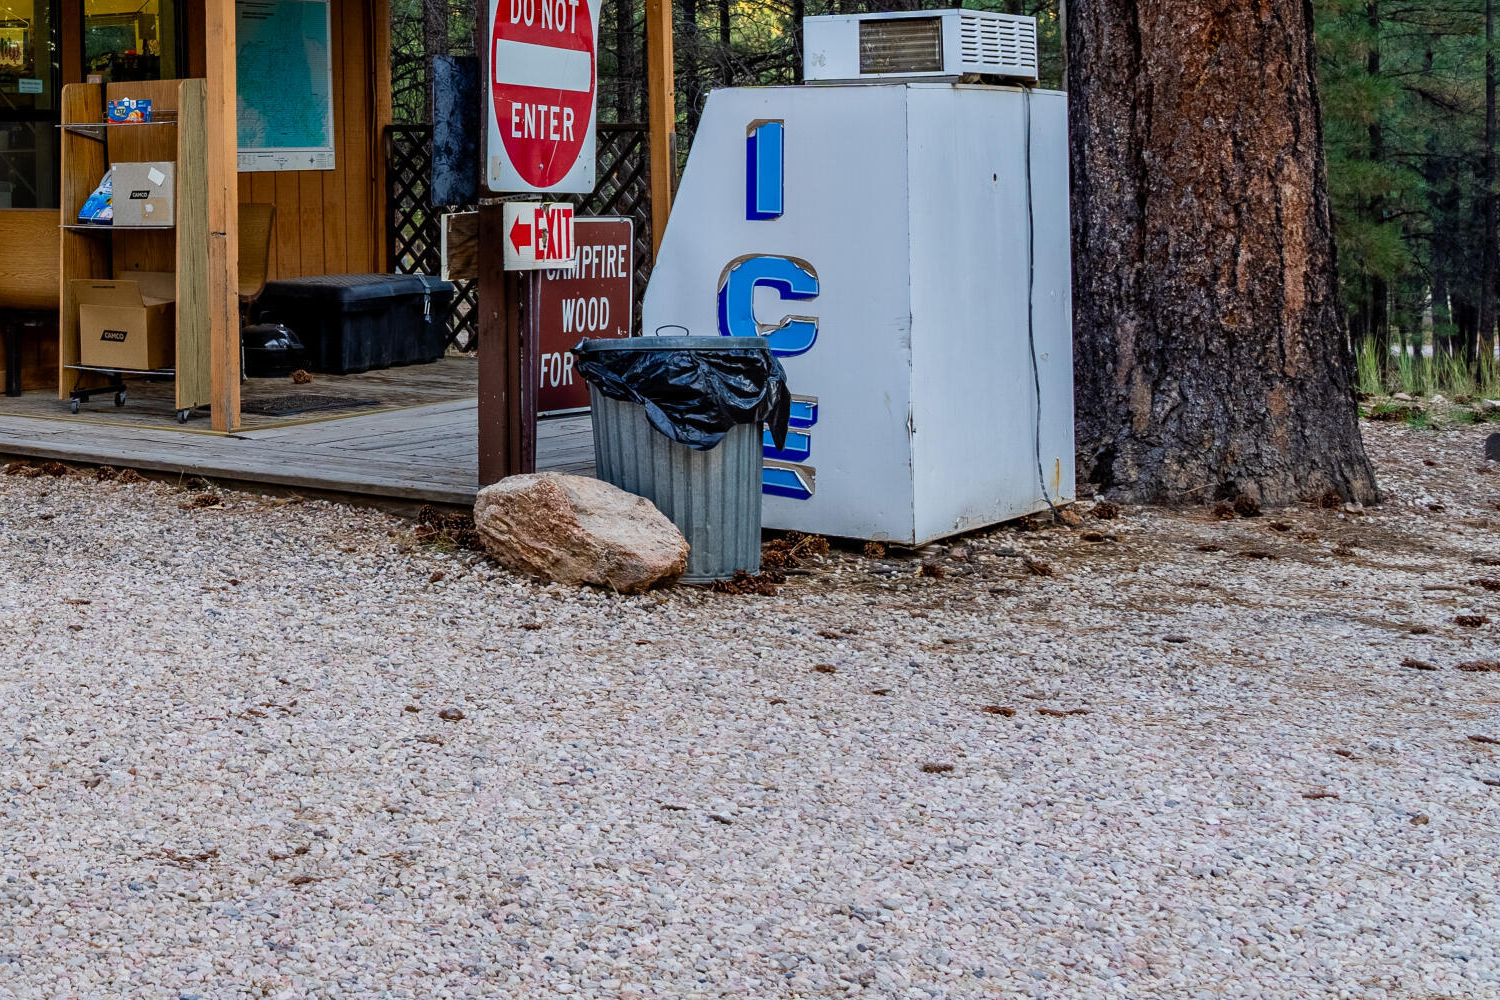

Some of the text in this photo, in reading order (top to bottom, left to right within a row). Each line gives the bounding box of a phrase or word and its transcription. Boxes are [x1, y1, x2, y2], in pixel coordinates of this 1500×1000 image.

[511, 102, 575, 142] ENTER
[534, 208, 573, 260] EXIT
[546, 244, 628, 281] MPFIRE
[561, 296, 610, 333] WOOD
[104, 331, 125, 340] CAMCO
[539, 352, 575, 389] FOR
